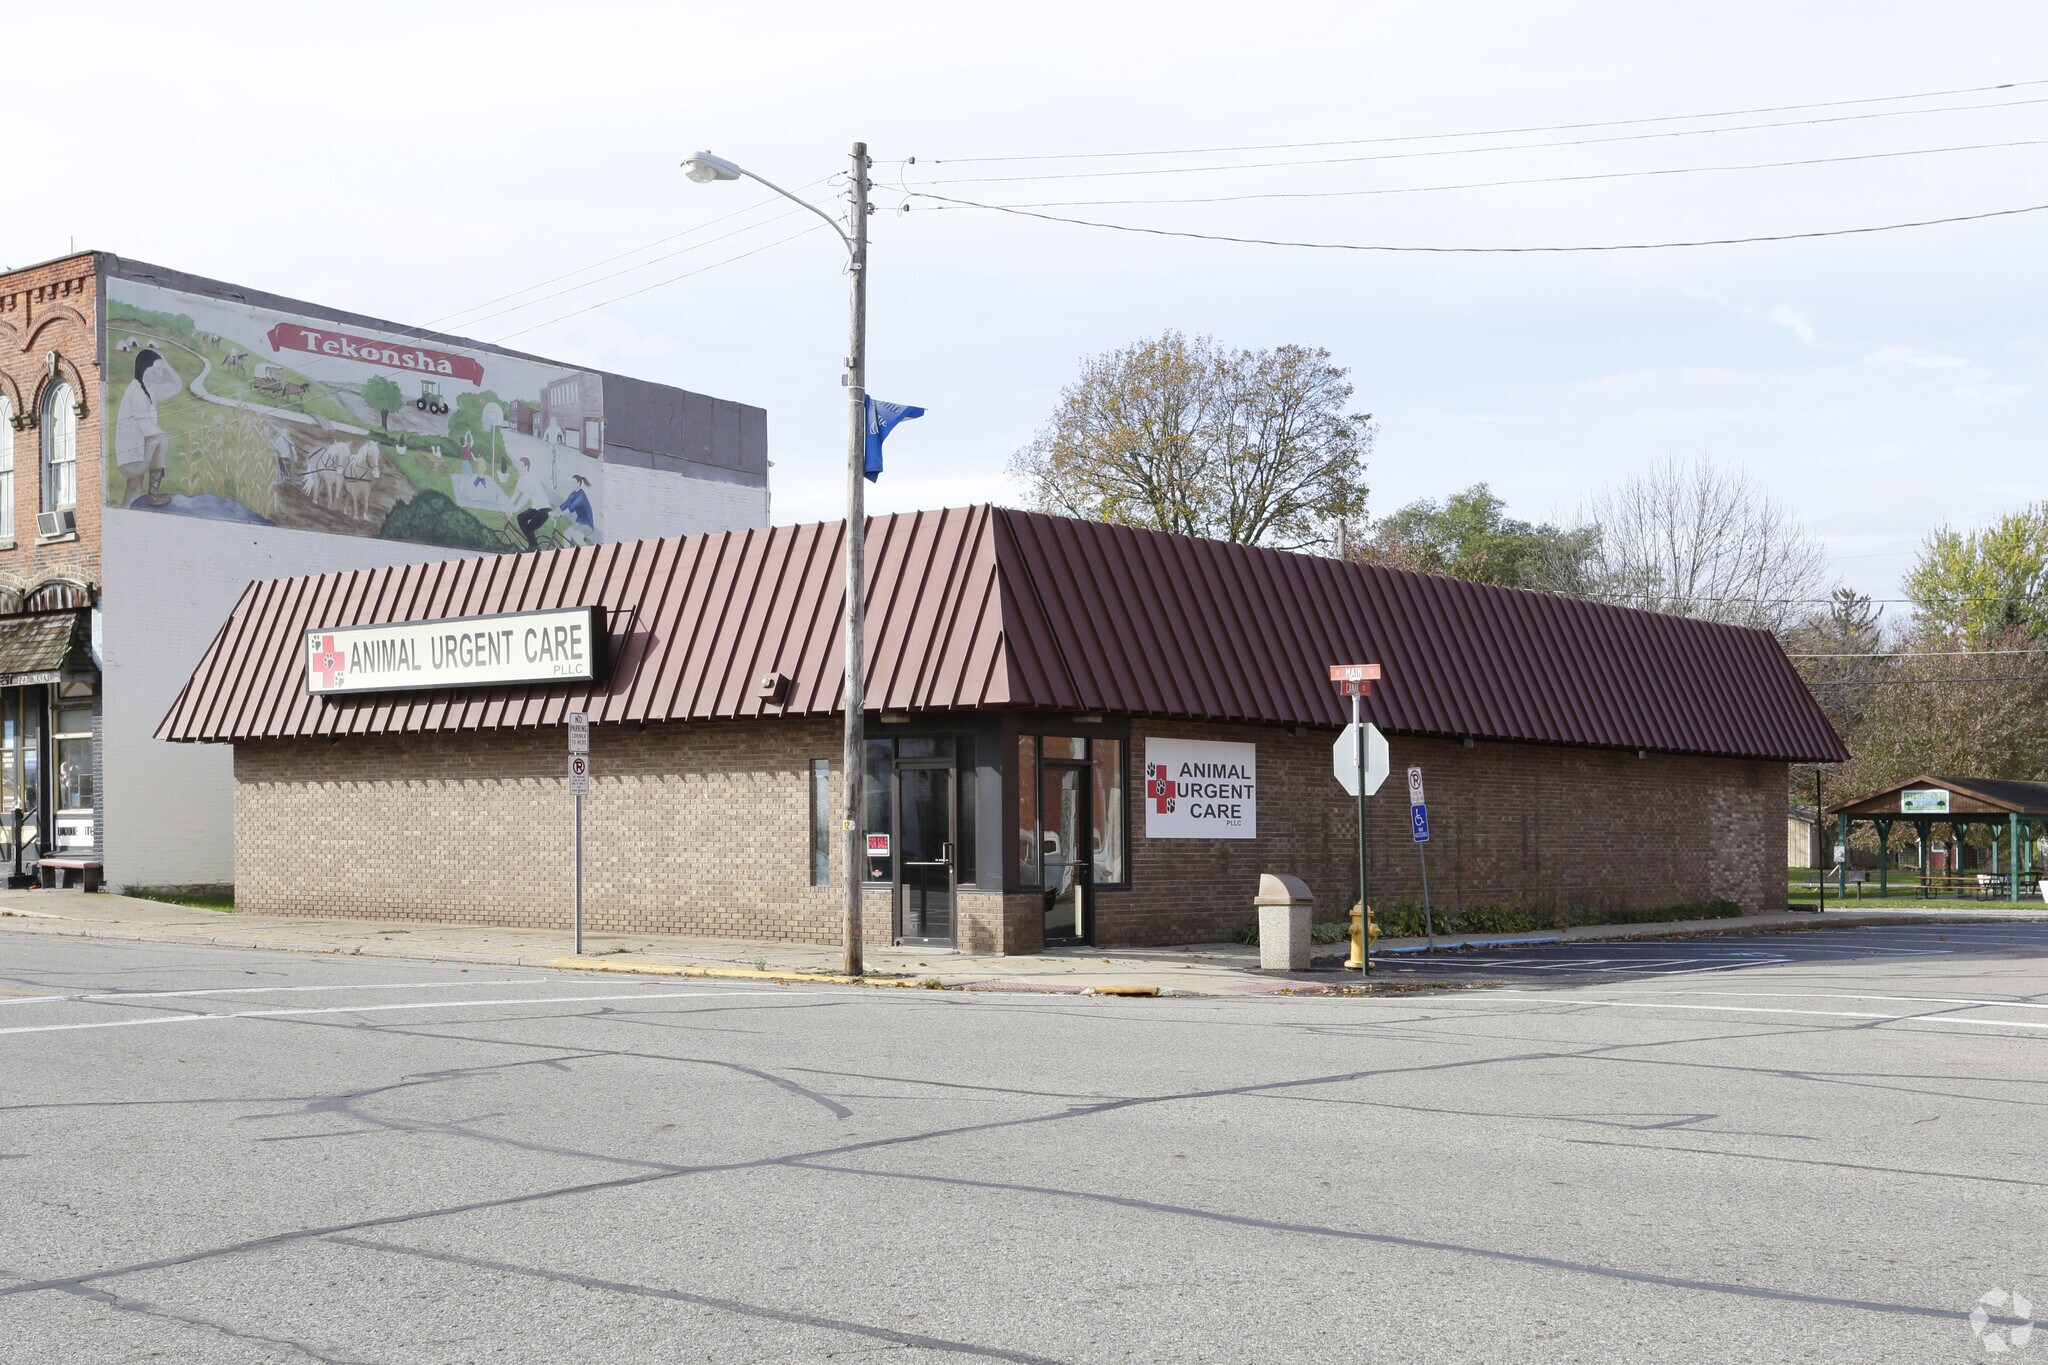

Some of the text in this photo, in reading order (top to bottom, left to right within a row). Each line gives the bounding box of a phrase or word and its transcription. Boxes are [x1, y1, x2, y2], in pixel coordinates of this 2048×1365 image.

[300, 331, 453, 375] Tekonsha
[349, 624, 583, 674] ANIMAL URGENT CARE
[553, 664, 583, 676] PLLC
[1345, 667, 1362, 679] MAIN
[575, 716, 582, 724] NO
[1179, 762, 1251, 780] ANIMAL
[1176, 783, 1254, 800] URGENT
[1190, 803, 1242, 819] CARE
